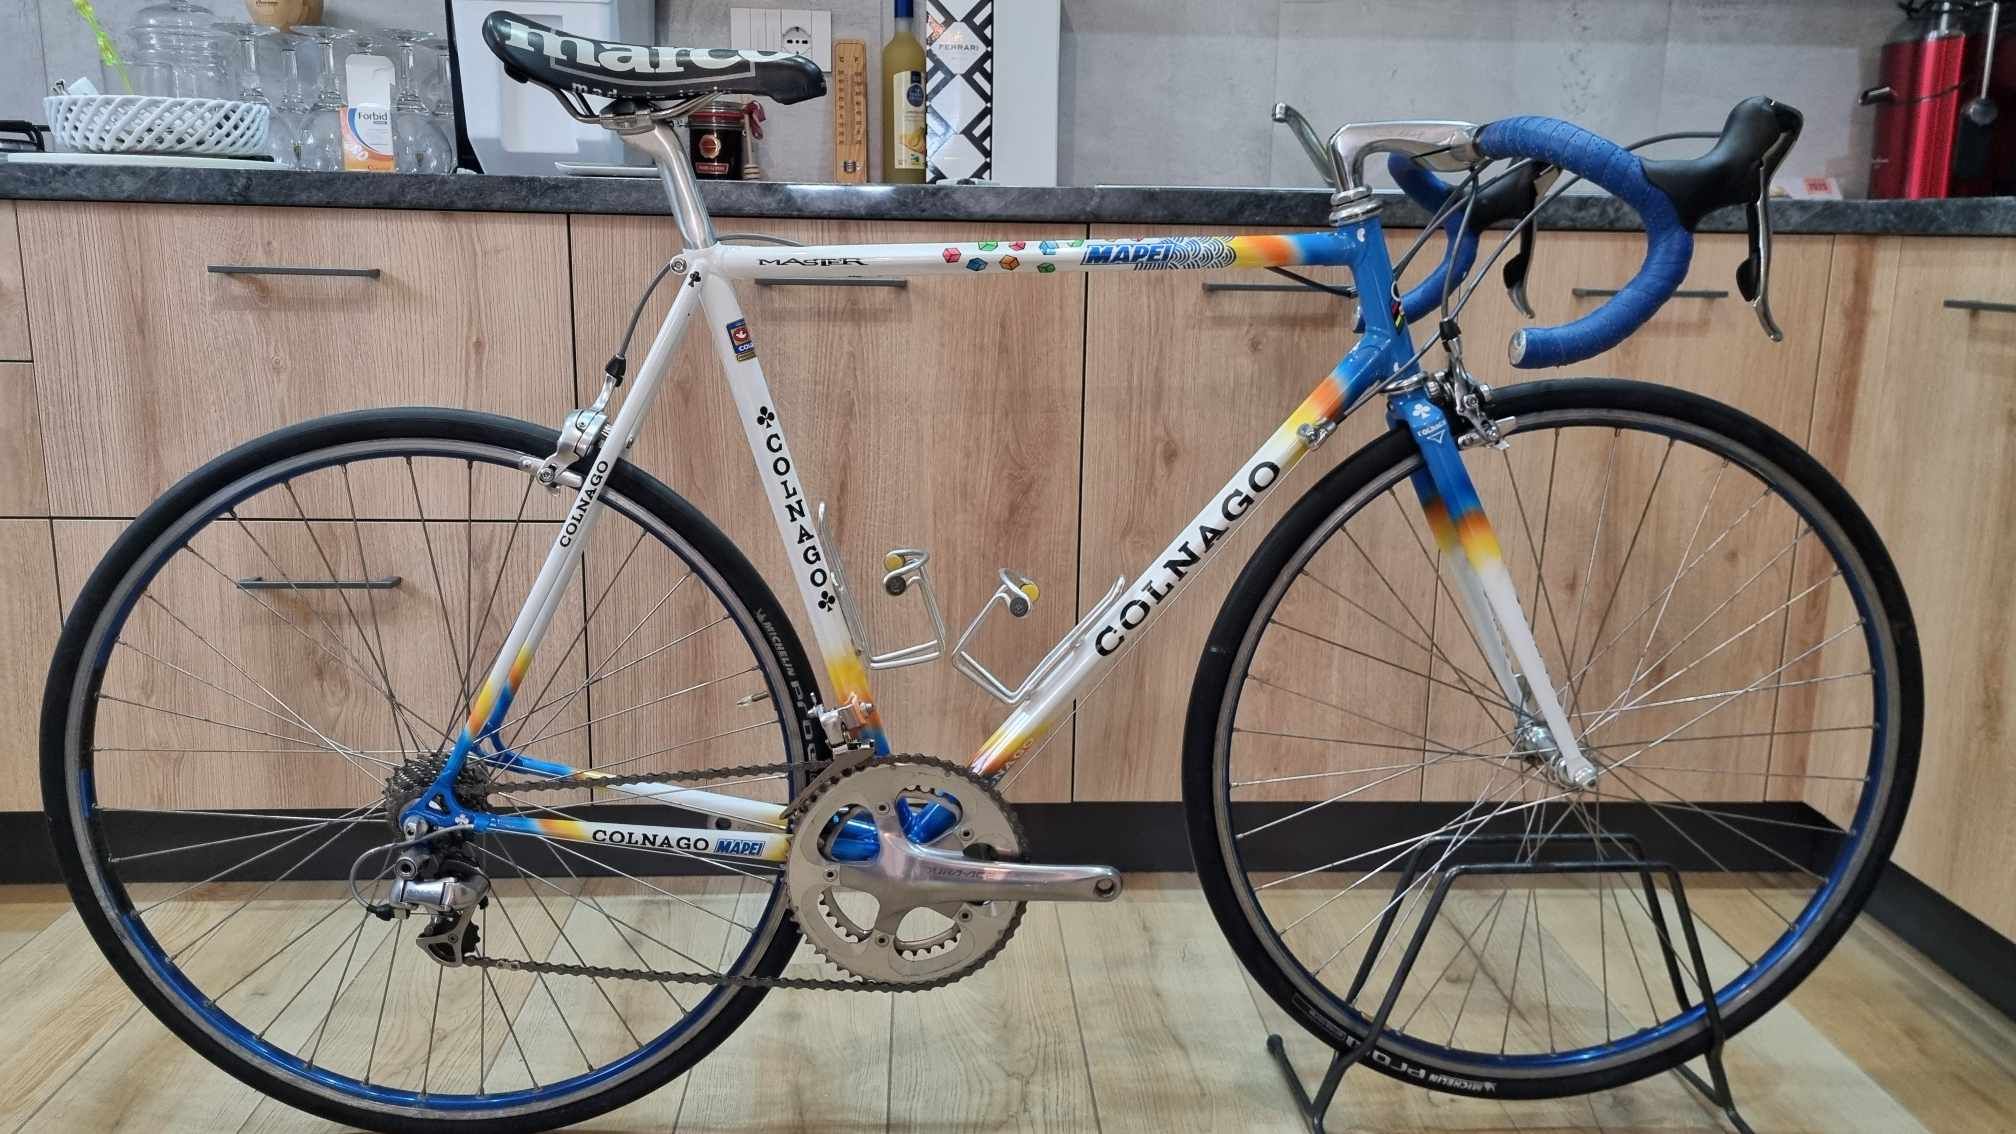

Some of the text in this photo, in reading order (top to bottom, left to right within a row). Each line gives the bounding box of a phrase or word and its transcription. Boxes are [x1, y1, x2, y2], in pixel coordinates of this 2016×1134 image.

[358, 111, 388, 121] Forbid
[758, 257, 869, 267] MASTER
[1085, 243, 1174, 264] MAPEI
[559, 460, 609, 548] COLNAGO
[766, 432, 828, 588] COLNAGO
[1094, 460, 1281, 657] COLNAGO
[762, 620, 796, 677] MICHELIN
[592, 829, 765, 857] COLNAGO MAPEI
[1428, 1072, 1484, 1093] MICHELIN
